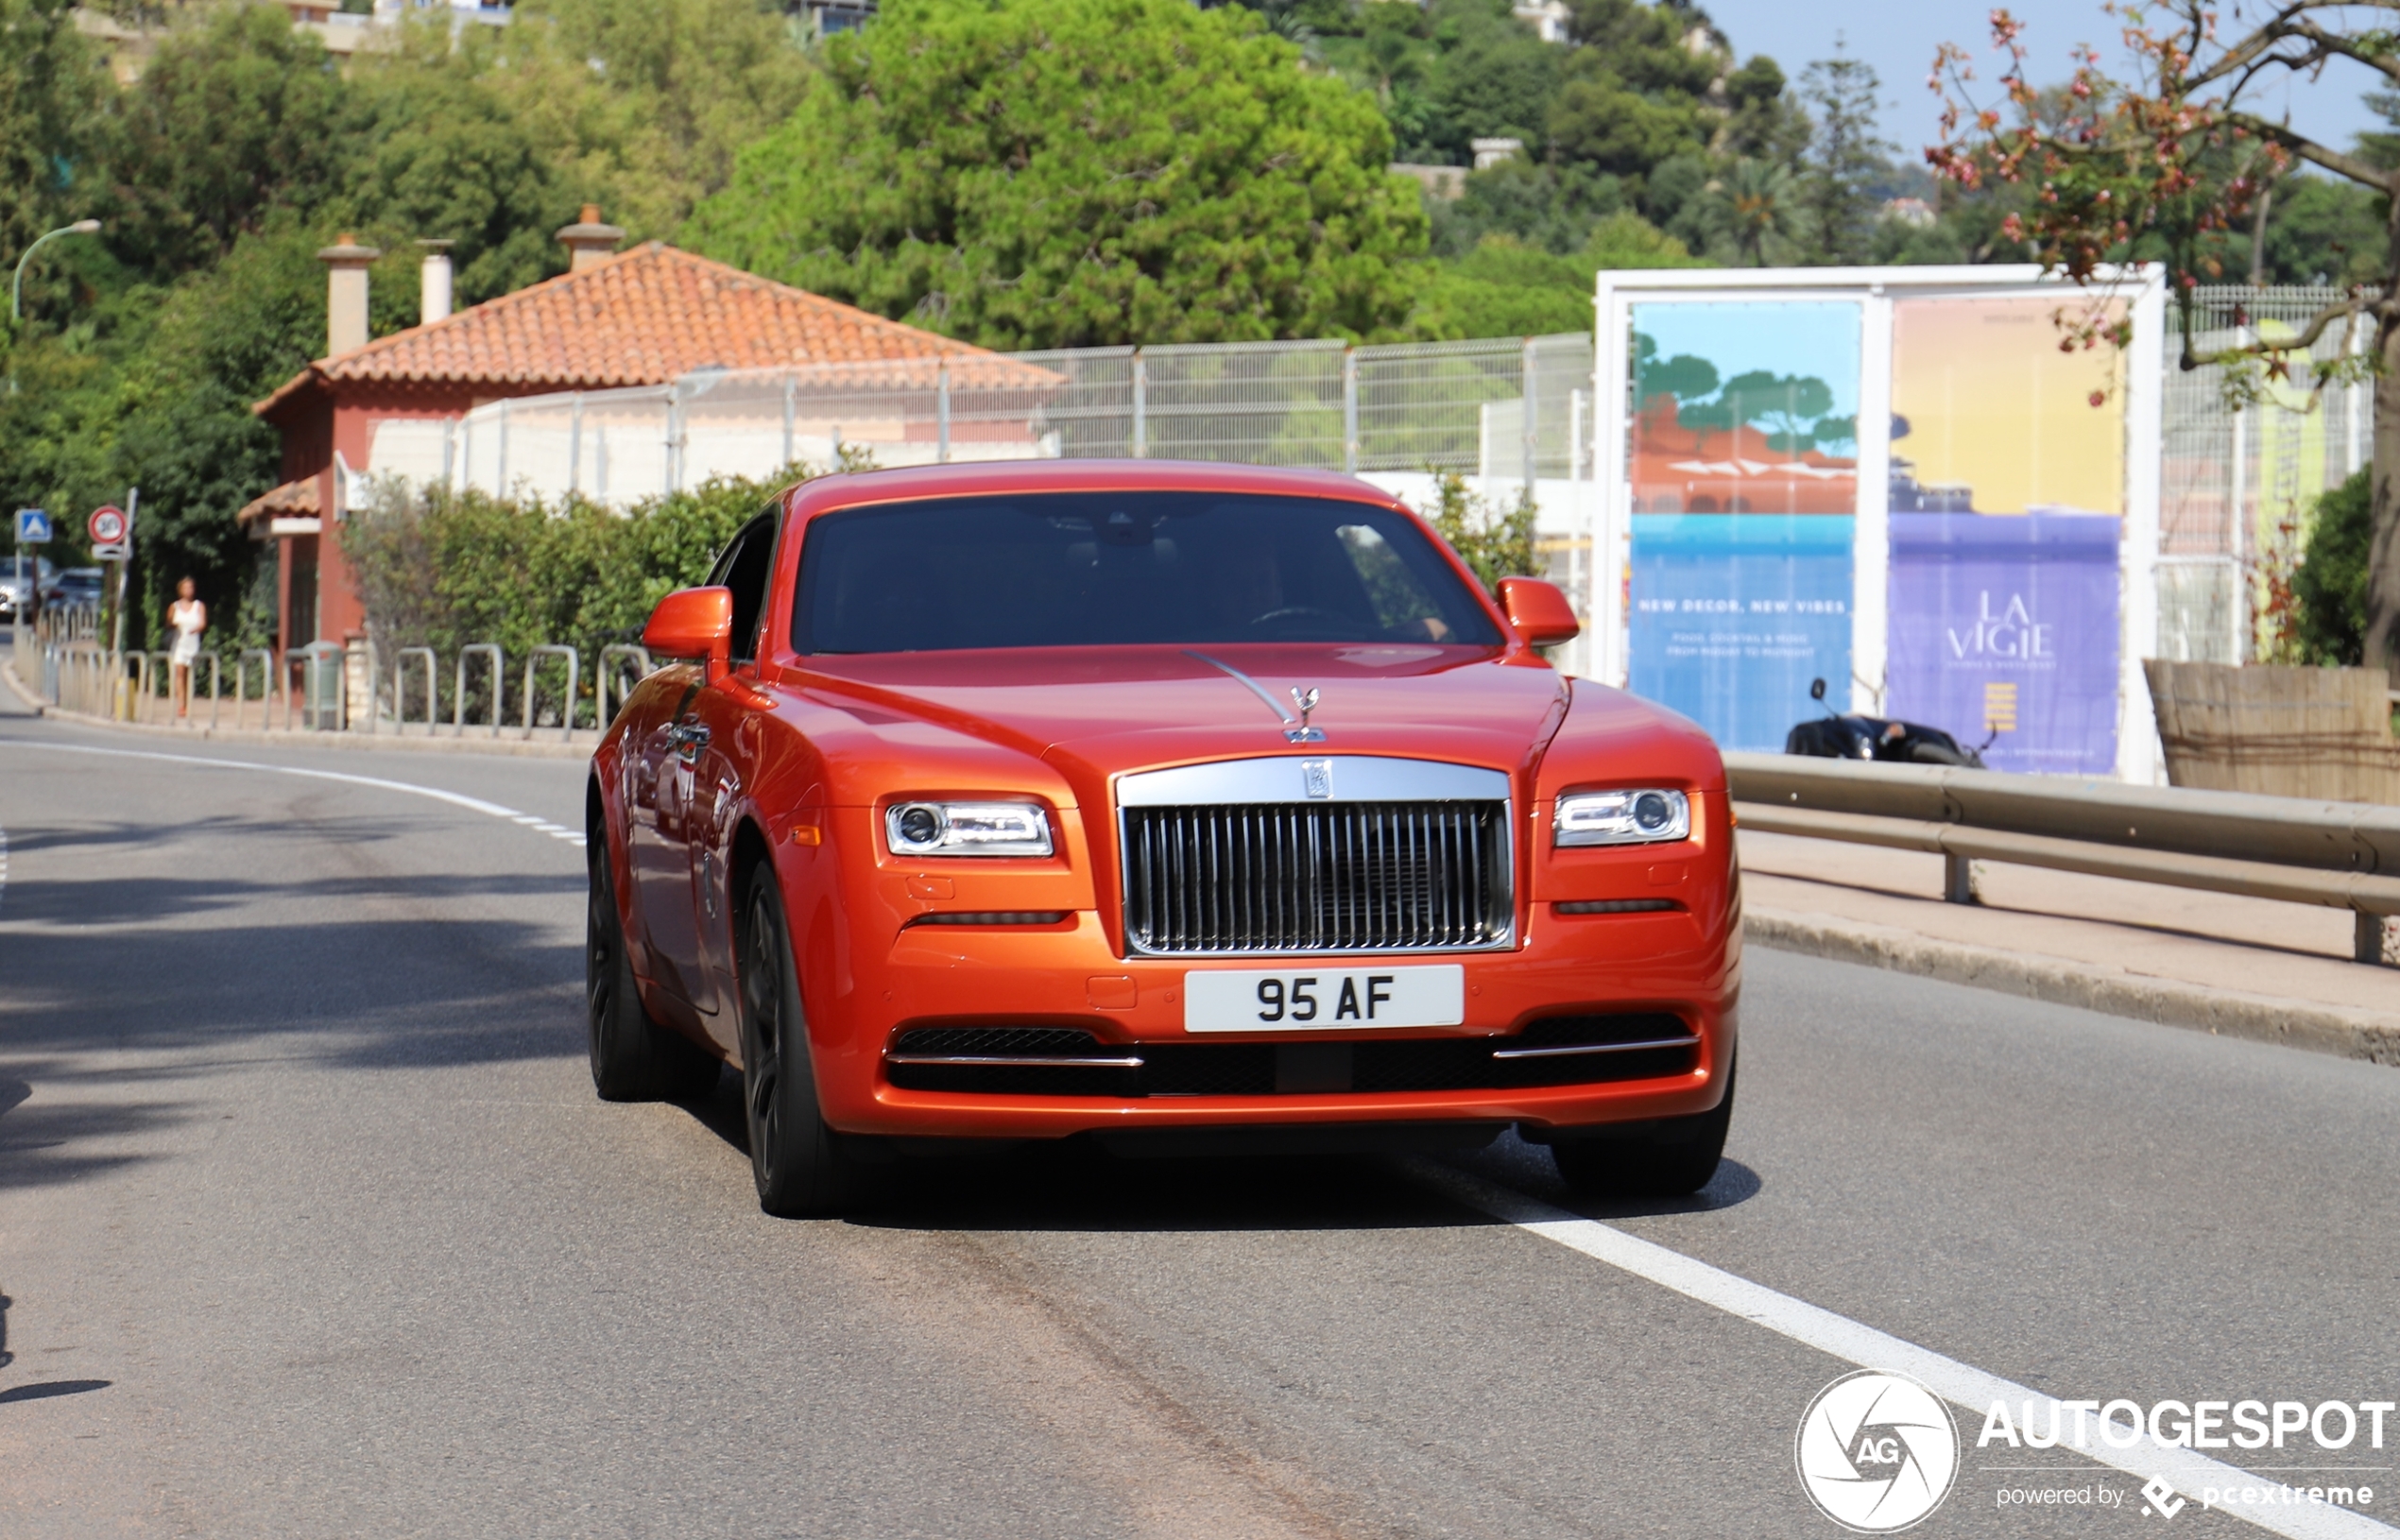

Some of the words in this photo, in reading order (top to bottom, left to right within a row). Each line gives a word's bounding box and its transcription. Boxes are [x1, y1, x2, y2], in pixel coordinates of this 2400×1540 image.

[1638, 599, 1676, 612] NEW
[1751, 600, 1790, 612] NEW
[1796, 600, 1845, 613] VIBES
[1980, 590, 2030, 625] LA
[1947, 621, 2055, 660] VIGIE
[1258, 977, 1317, 1021] 95
[1335, 976, 1394, 1020] AF
